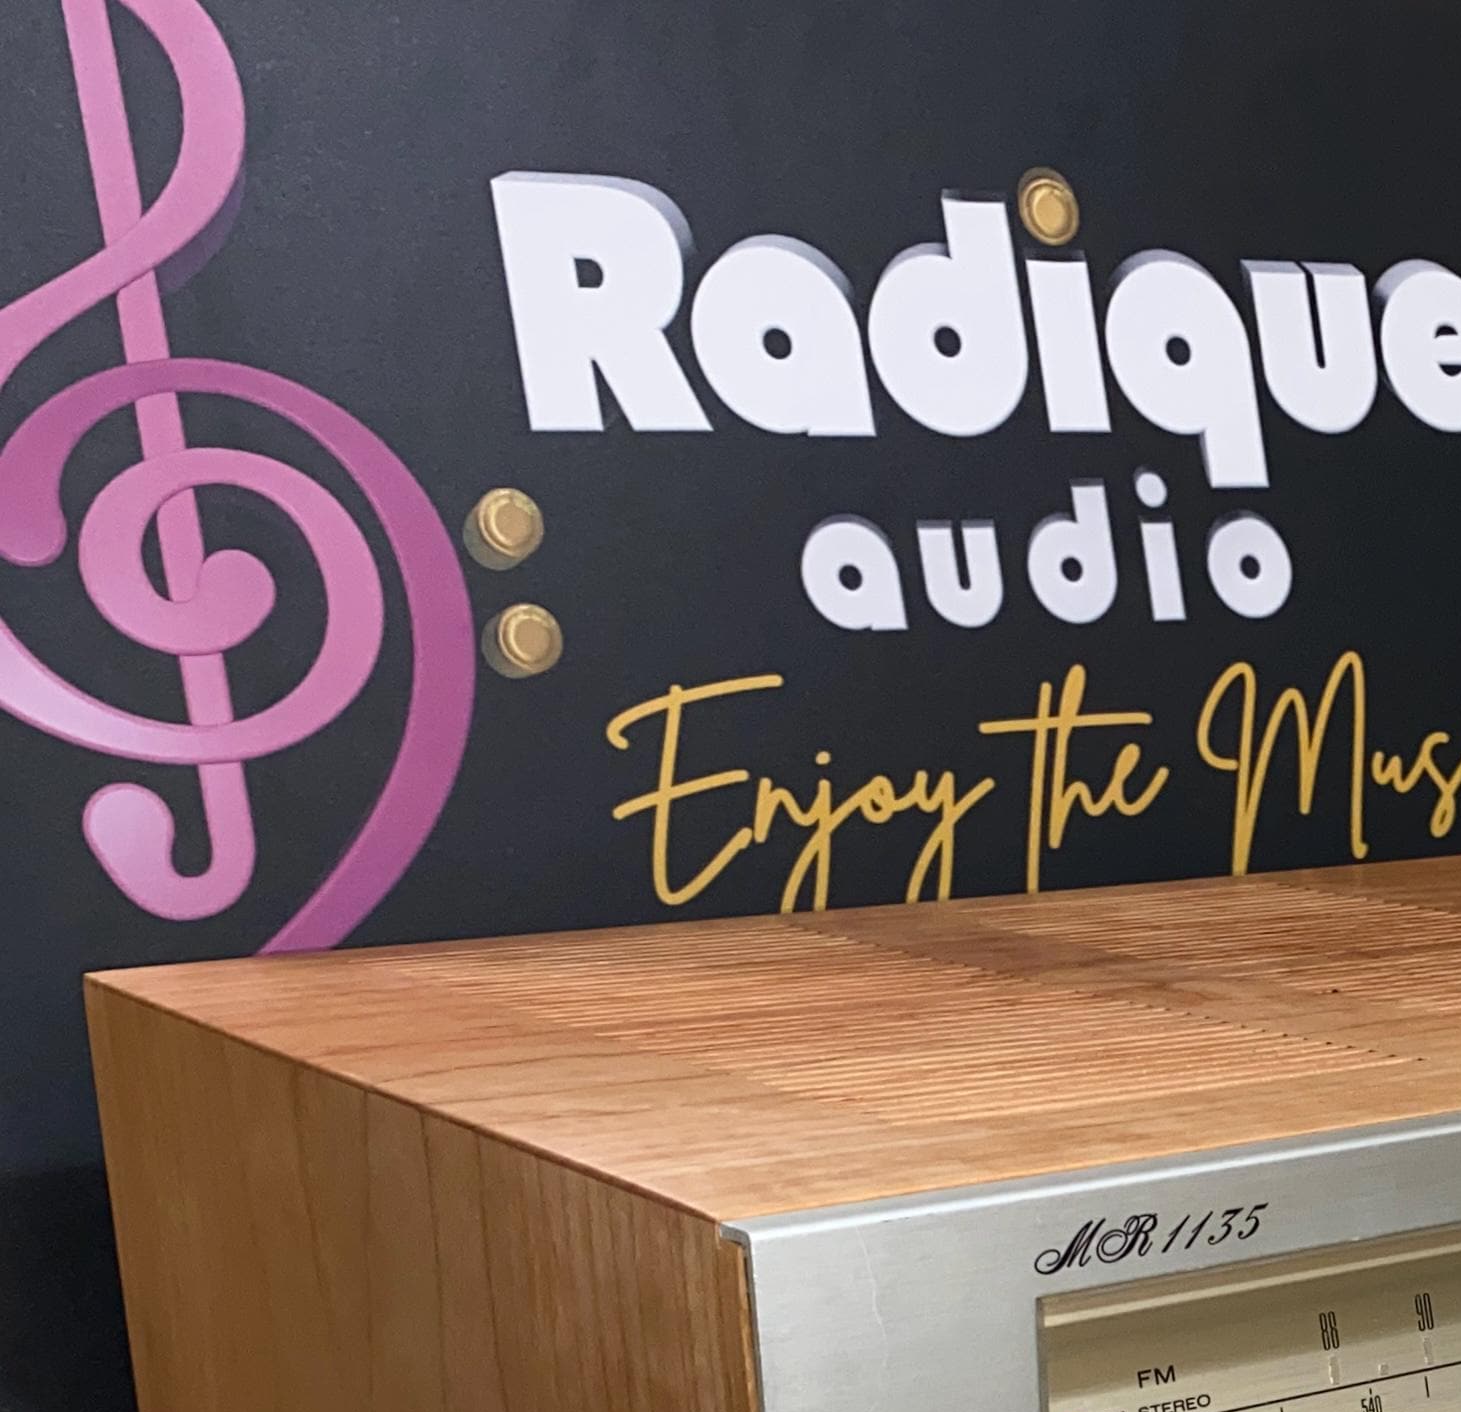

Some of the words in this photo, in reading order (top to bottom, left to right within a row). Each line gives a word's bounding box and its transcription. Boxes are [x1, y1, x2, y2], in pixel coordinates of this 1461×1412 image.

[801, 466, 1293, 631] audio
[605, 674, 995, 913] Enjoy
[1136, 1364, 1177, 1389] FM
[1318, 1310, 1341, 1351] 88
[1413, 1292, 1435, 1332] 90
